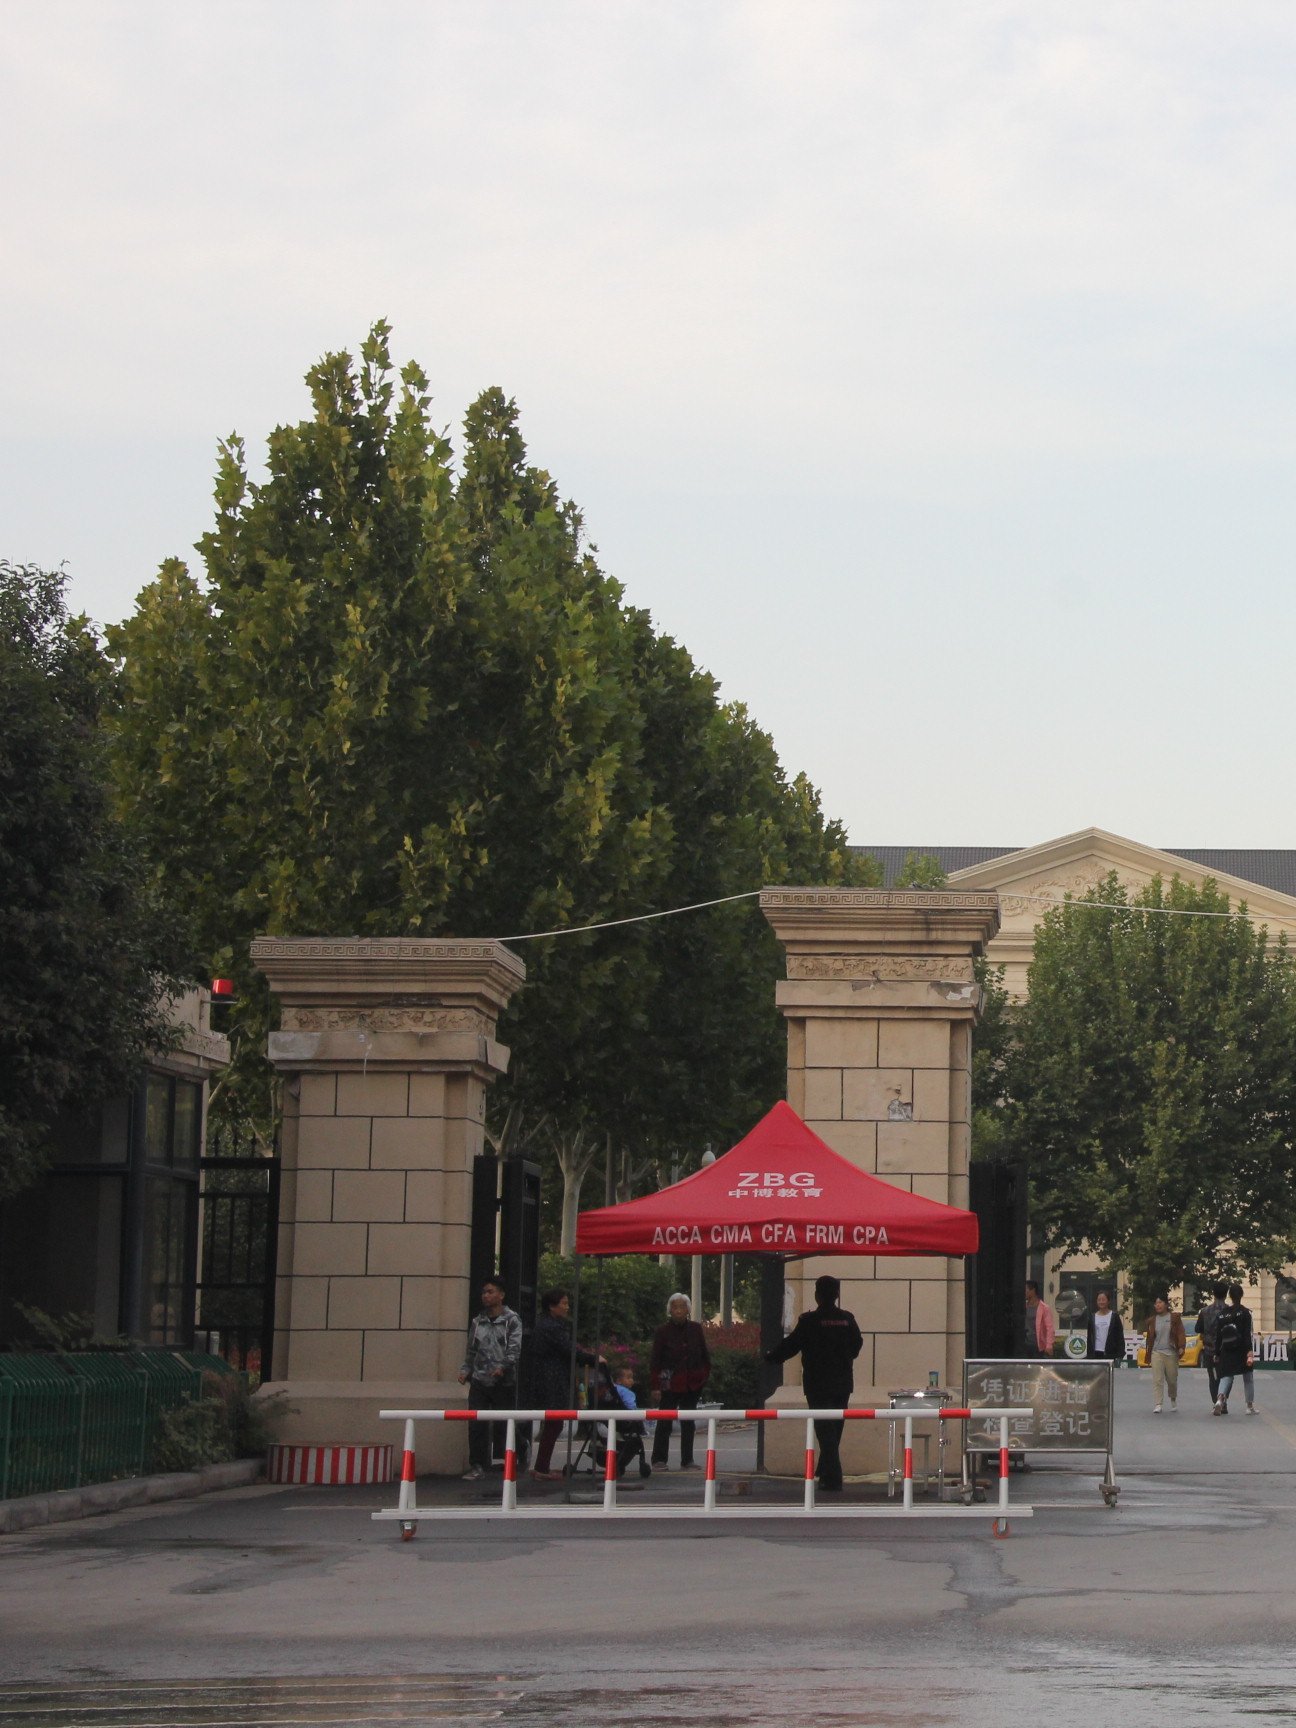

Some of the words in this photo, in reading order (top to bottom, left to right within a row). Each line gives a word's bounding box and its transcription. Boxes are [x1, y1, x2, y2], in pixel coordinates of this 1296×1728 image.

[737, 1172, 815, 1187] ZBG
[728, 1188, 823, 1198] 中博教育
[652, 1226, 702, 1245] ACCA
[710, 1225, 752, 1243] CMA
[761, 1223, 797, 1243] CFA
[806, 1225, 844, 1244] FRM
[853, 1225, 889, 1245] CPA
[980, 1378, 1089, 1404] 凭证进出
